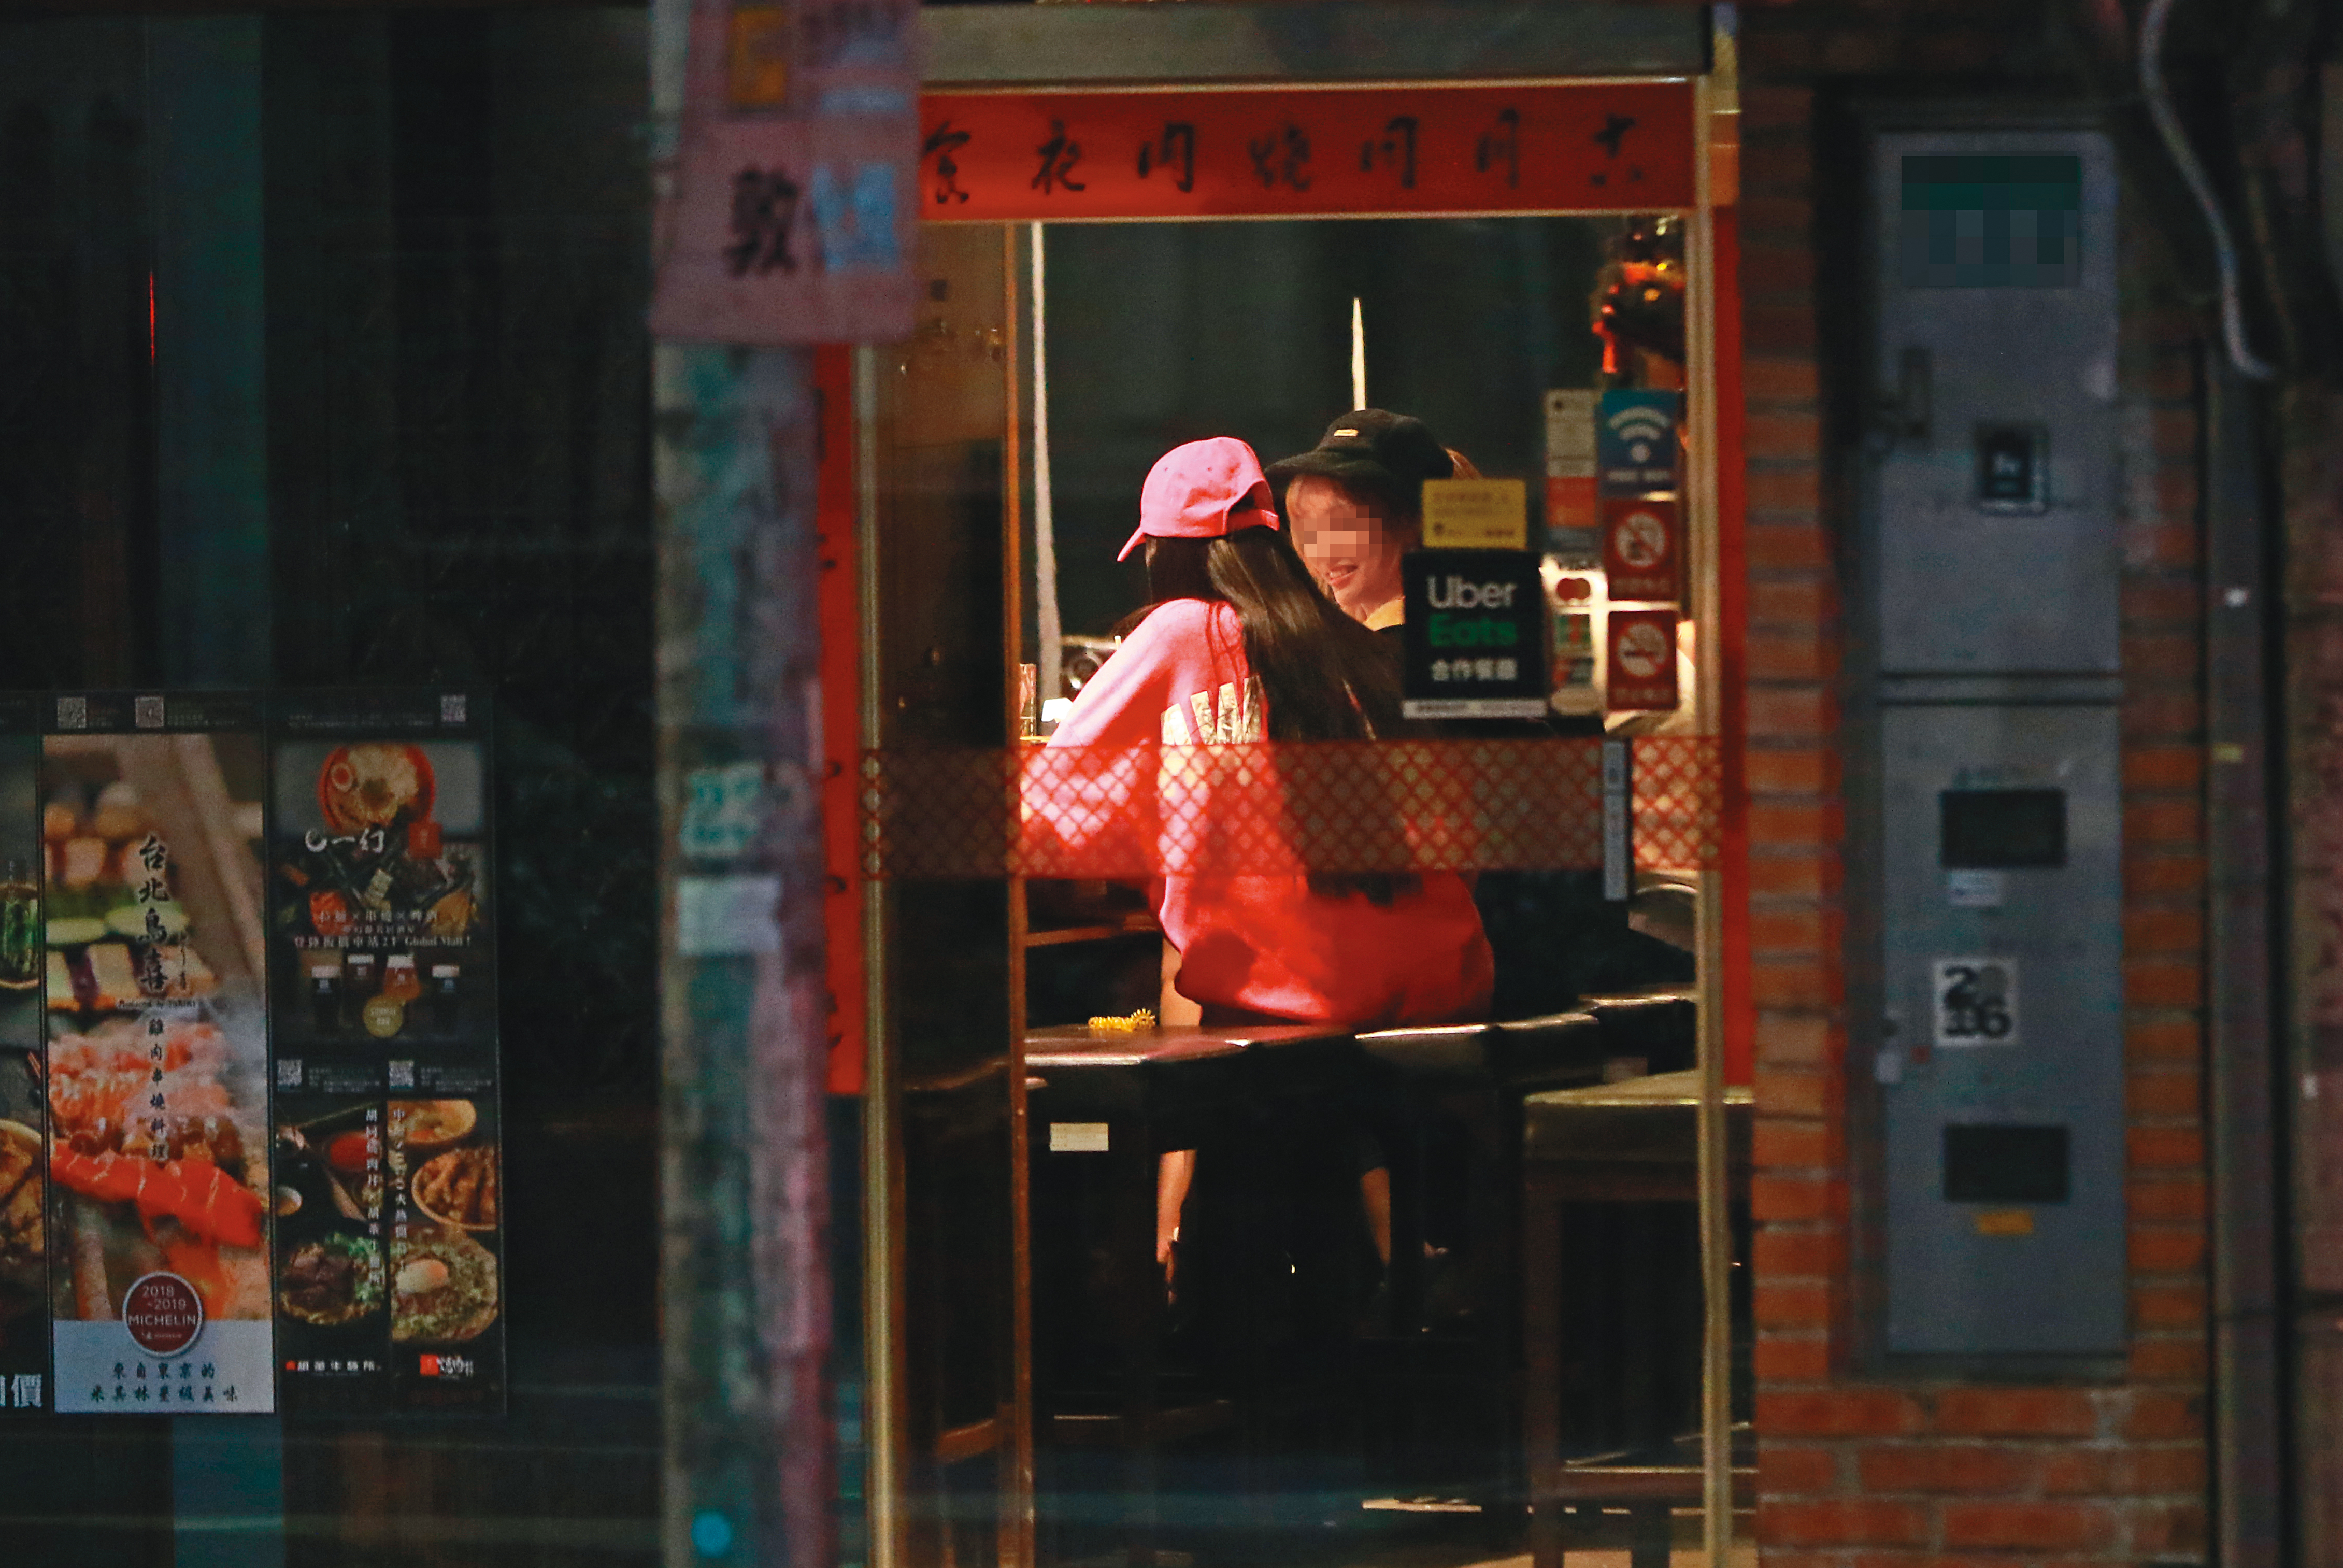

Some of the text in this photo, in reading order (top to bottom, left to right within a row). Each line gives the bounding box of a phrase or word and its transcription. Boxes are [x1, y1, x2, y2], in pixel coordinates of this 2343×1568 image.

[1427, 574, 1517, 608] Uber
[1429, 614, 1518, 647] Eats
[143, 1286, 174, 1297] 2018
[128, 1316, 196, 1325] MICHELIN
